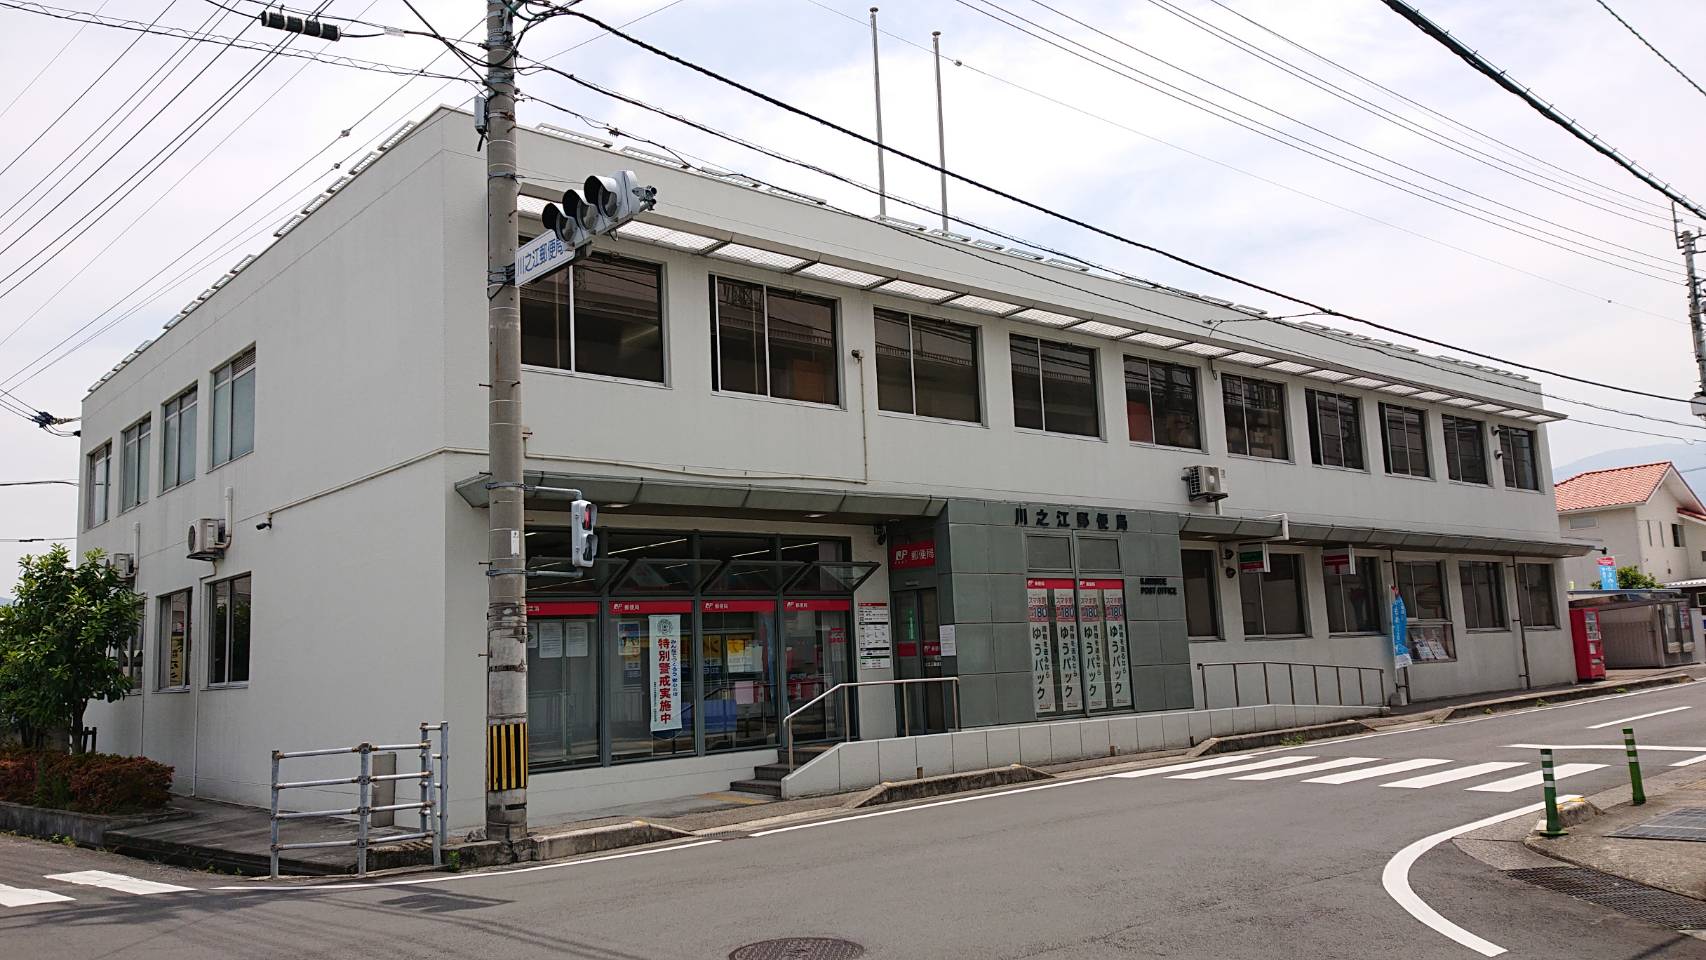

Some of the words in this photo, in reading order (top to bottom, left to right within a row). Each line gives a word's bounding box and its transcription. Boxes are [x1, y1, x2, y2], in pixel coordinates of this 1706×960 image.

[517, 238, 564, 277] 川之江郵便局
[911, 547, 935, 560] 郵便局
[1014, 507, 1128, 531] 川之江郵便局
[658, 637, 673, 726] 特別警戒実施中
[1032, 626, 1046, 700] ゆうパック
[1060, 626, 1073, 698] ゆうパック
[1083, 626, 1097, 697] ゆうパック
[1109, 626, 1122, 695] ゆうパック
